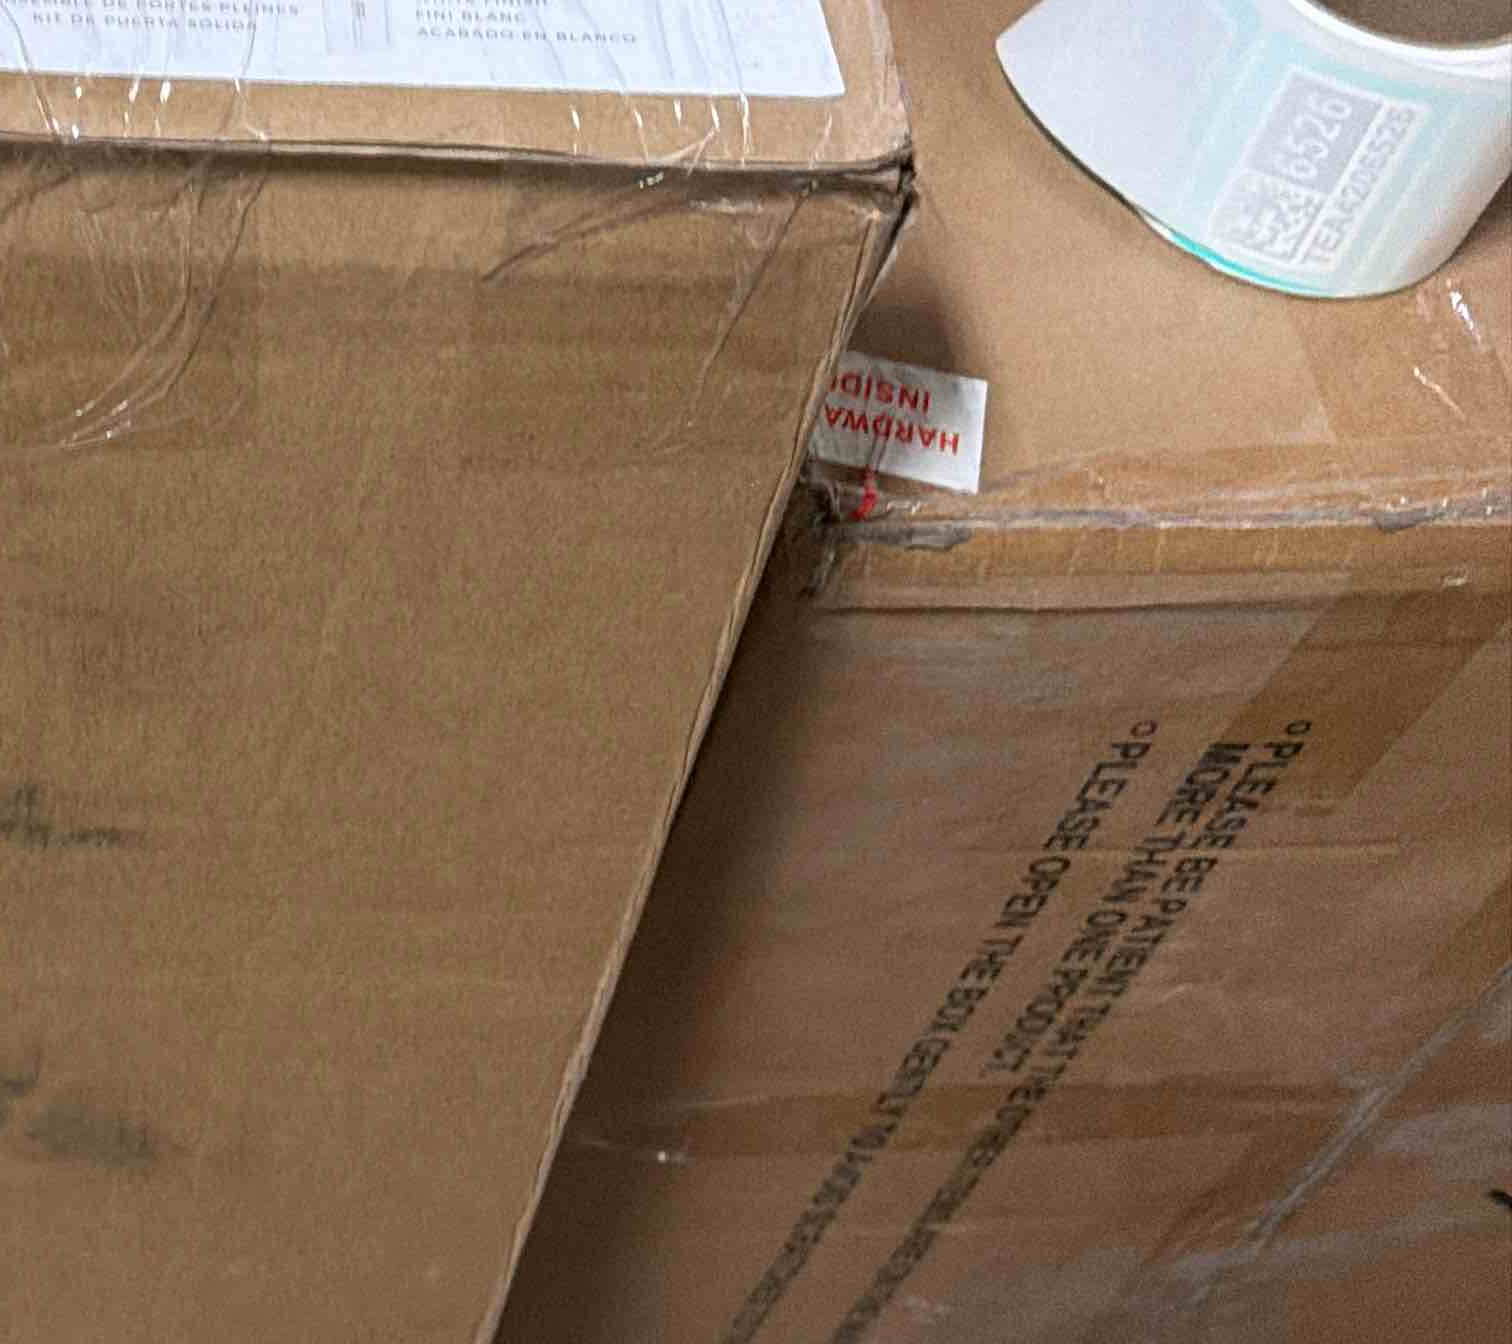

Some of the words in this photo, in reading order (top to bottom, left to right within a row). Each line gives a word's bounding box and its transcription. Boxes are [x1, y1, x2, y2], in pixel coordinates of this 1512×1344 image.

[1043, 742, 1153, 850] PLEASE
[1154, 742, 1250, 826] MORE
[1191, 741, 1305, 849] PLEASE
[993, 856, 1071, 928] OPEN
[1101, 831, 1187, 902] THAN
[1160, 857, 1220, 896] BE
[1063, 910, 1128, 962] ONE
